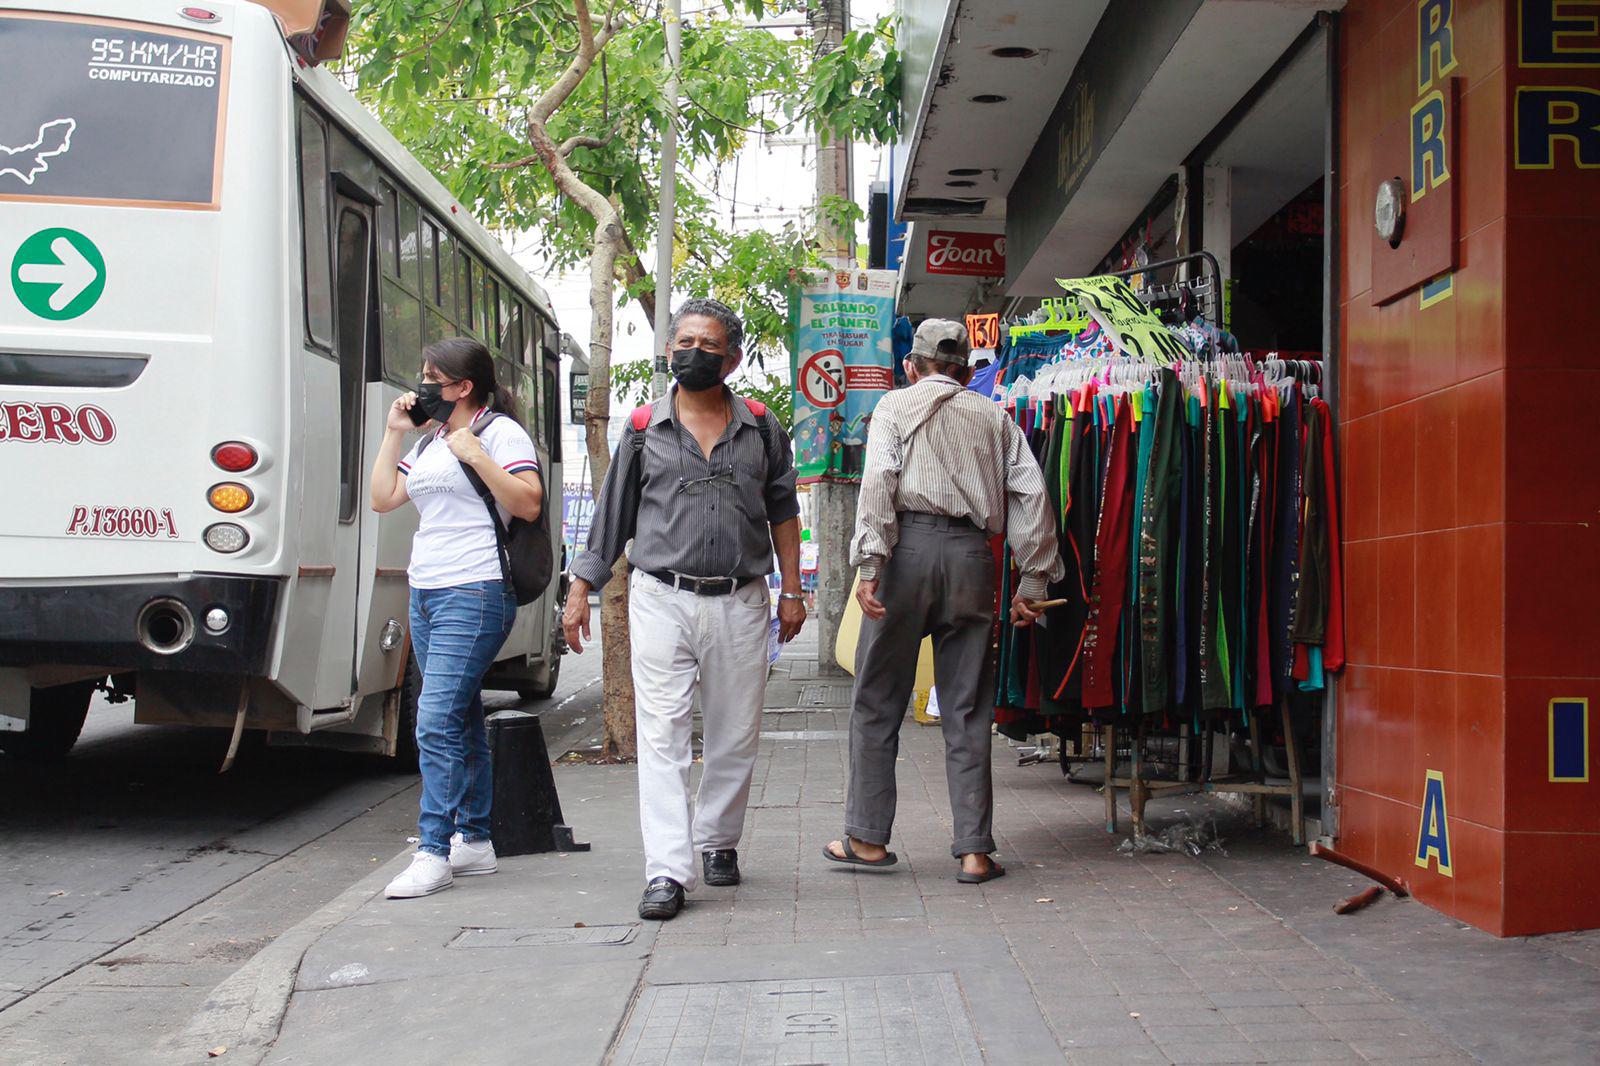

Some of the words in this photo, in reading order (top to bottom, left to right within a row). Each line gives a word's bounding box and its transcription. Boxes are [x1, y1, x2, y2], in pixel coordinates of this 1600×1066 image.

[91, 38, 125, 63] 95
[130, 41, 217, 69] KM/HR
[88, 68, 215, 88] COMPUTARIZADO
[929, 235, 994, 266] Joan
[811, 318, 825, 329] EL
[0, 401, 117, 445] ERO
[66, 505, 180, 538] P.13660-1
[1414, 769, 1453, 878] A
